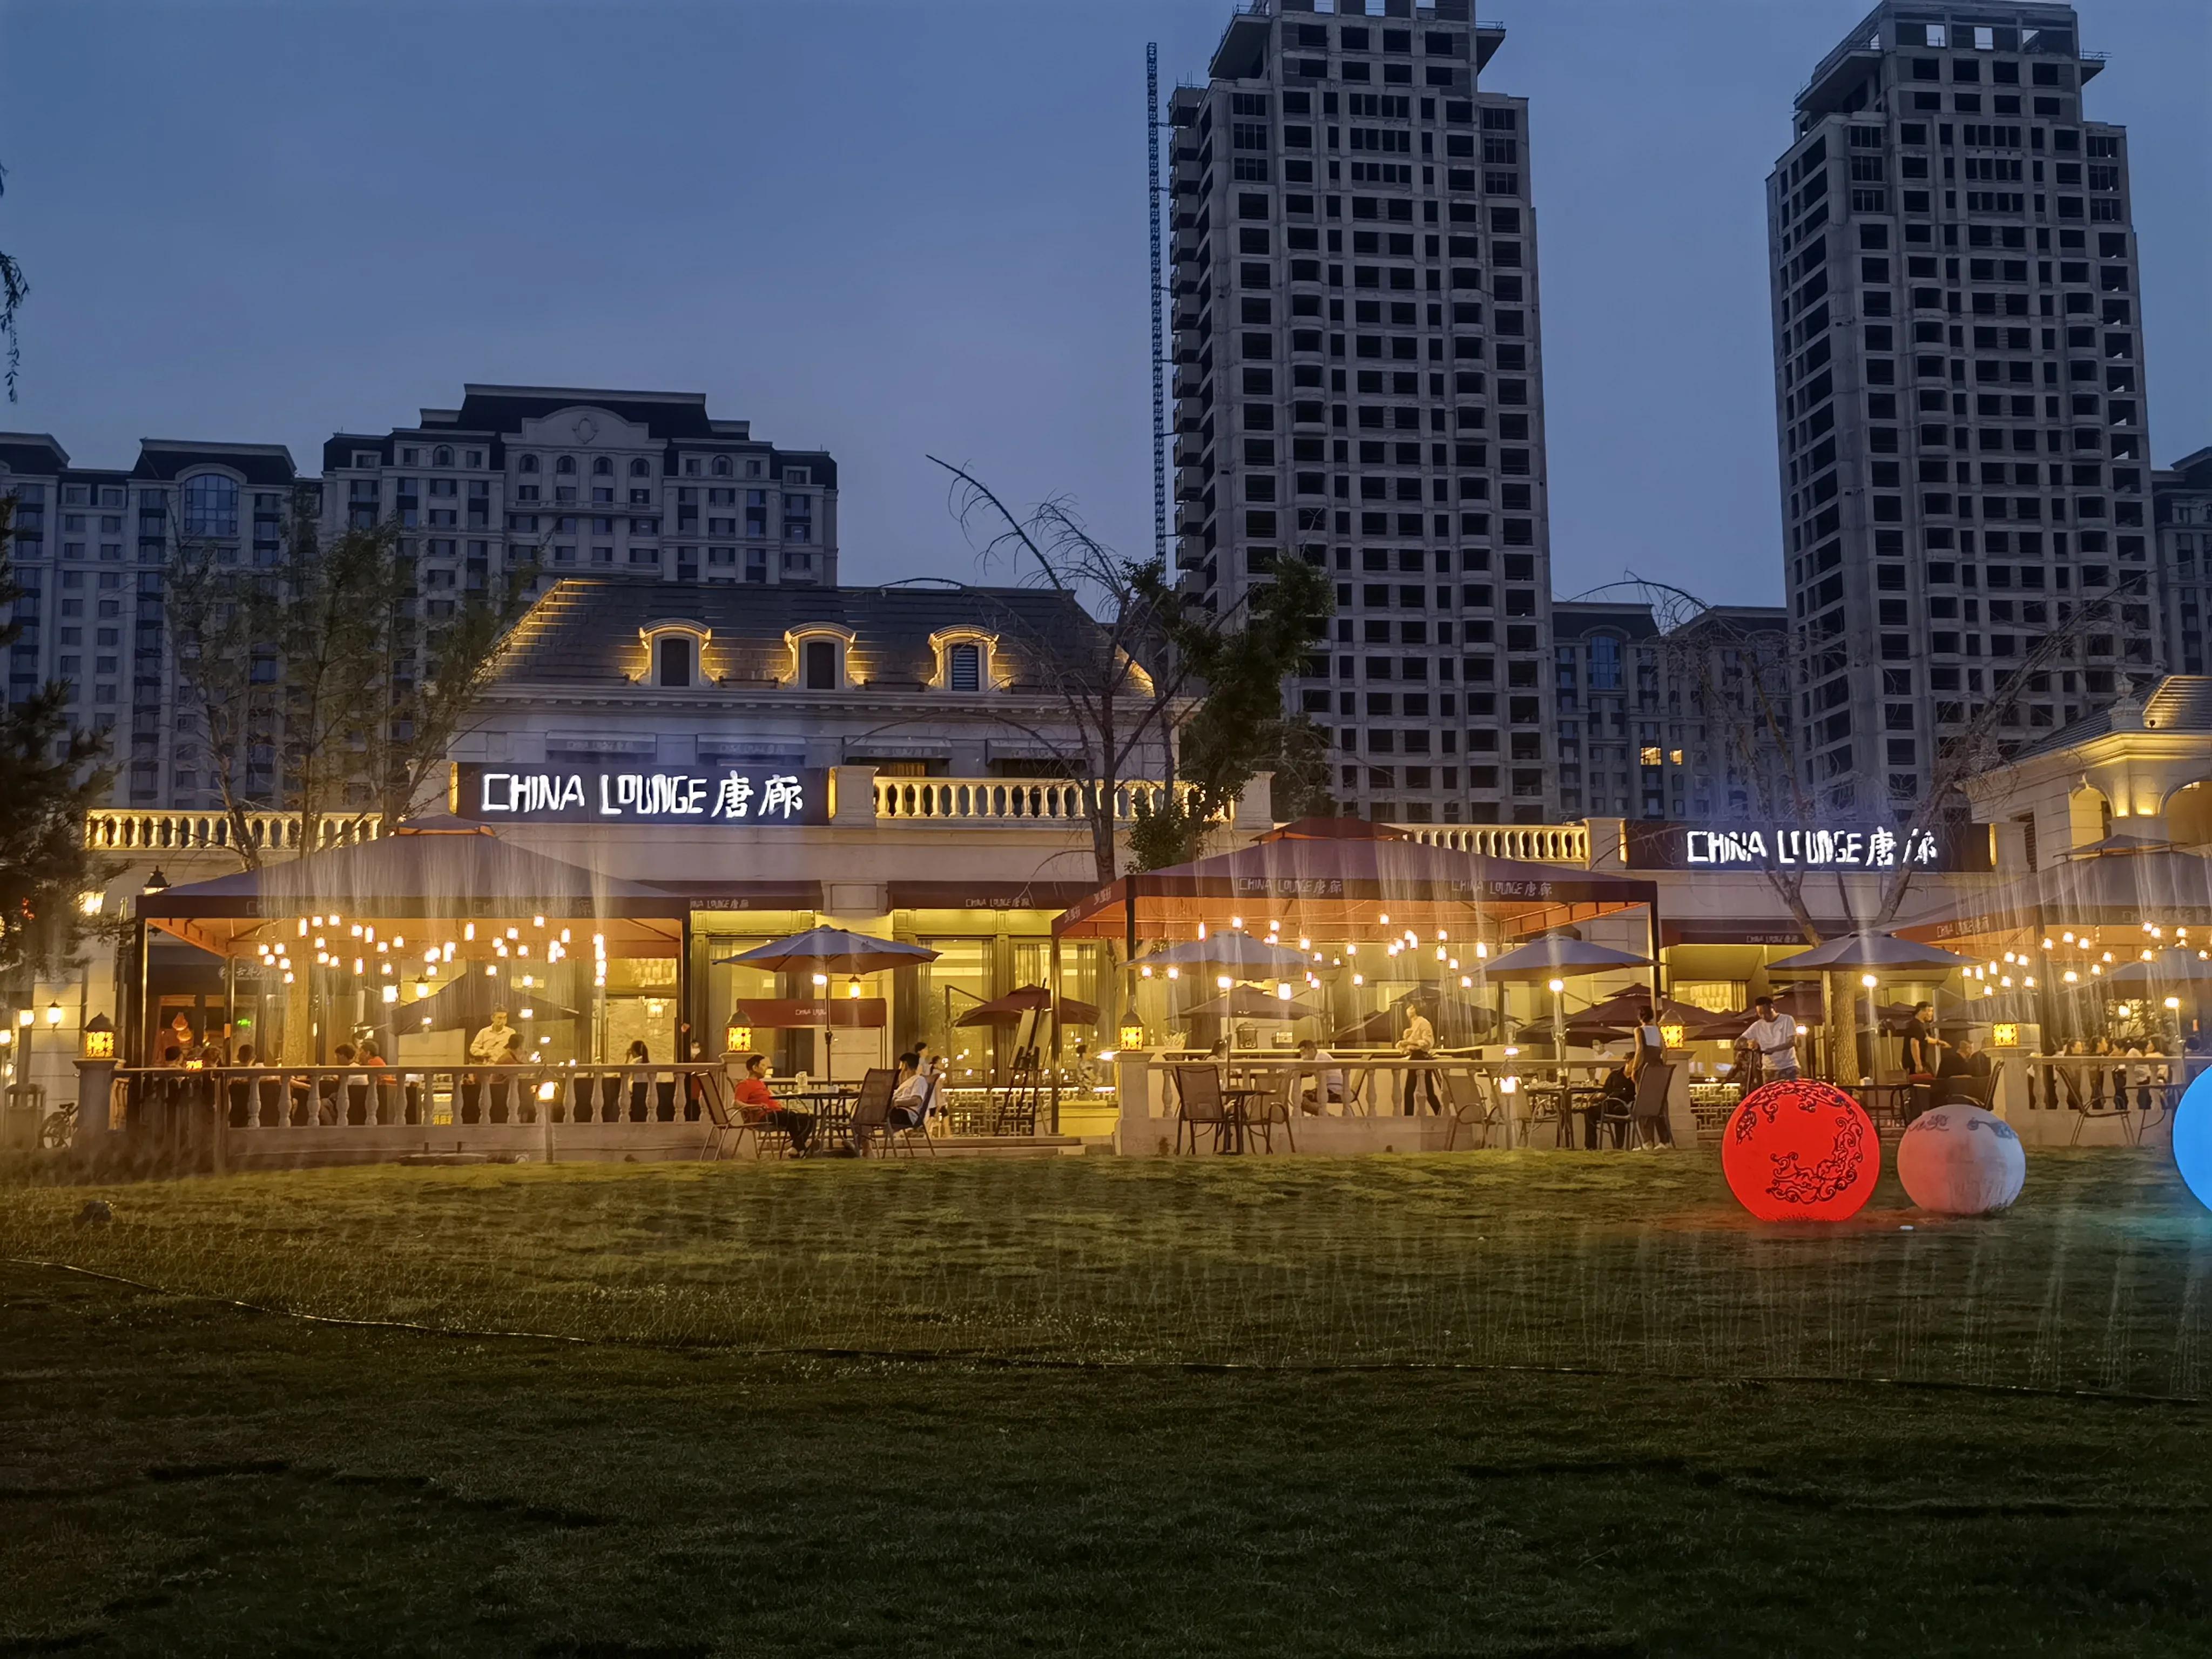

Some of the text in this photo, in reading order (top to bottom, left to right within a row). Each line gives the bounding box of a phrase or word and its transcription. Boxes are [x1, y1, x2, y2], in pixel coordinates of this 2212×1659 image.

[482, 770, 804, 819] CHINA LOUNGE 唐廊
[1687, 830, 1768, 864] CHINA
[1239, 878, 1272, 891] CHINA
[1489, 881, 1523, 895] LOUNGE
